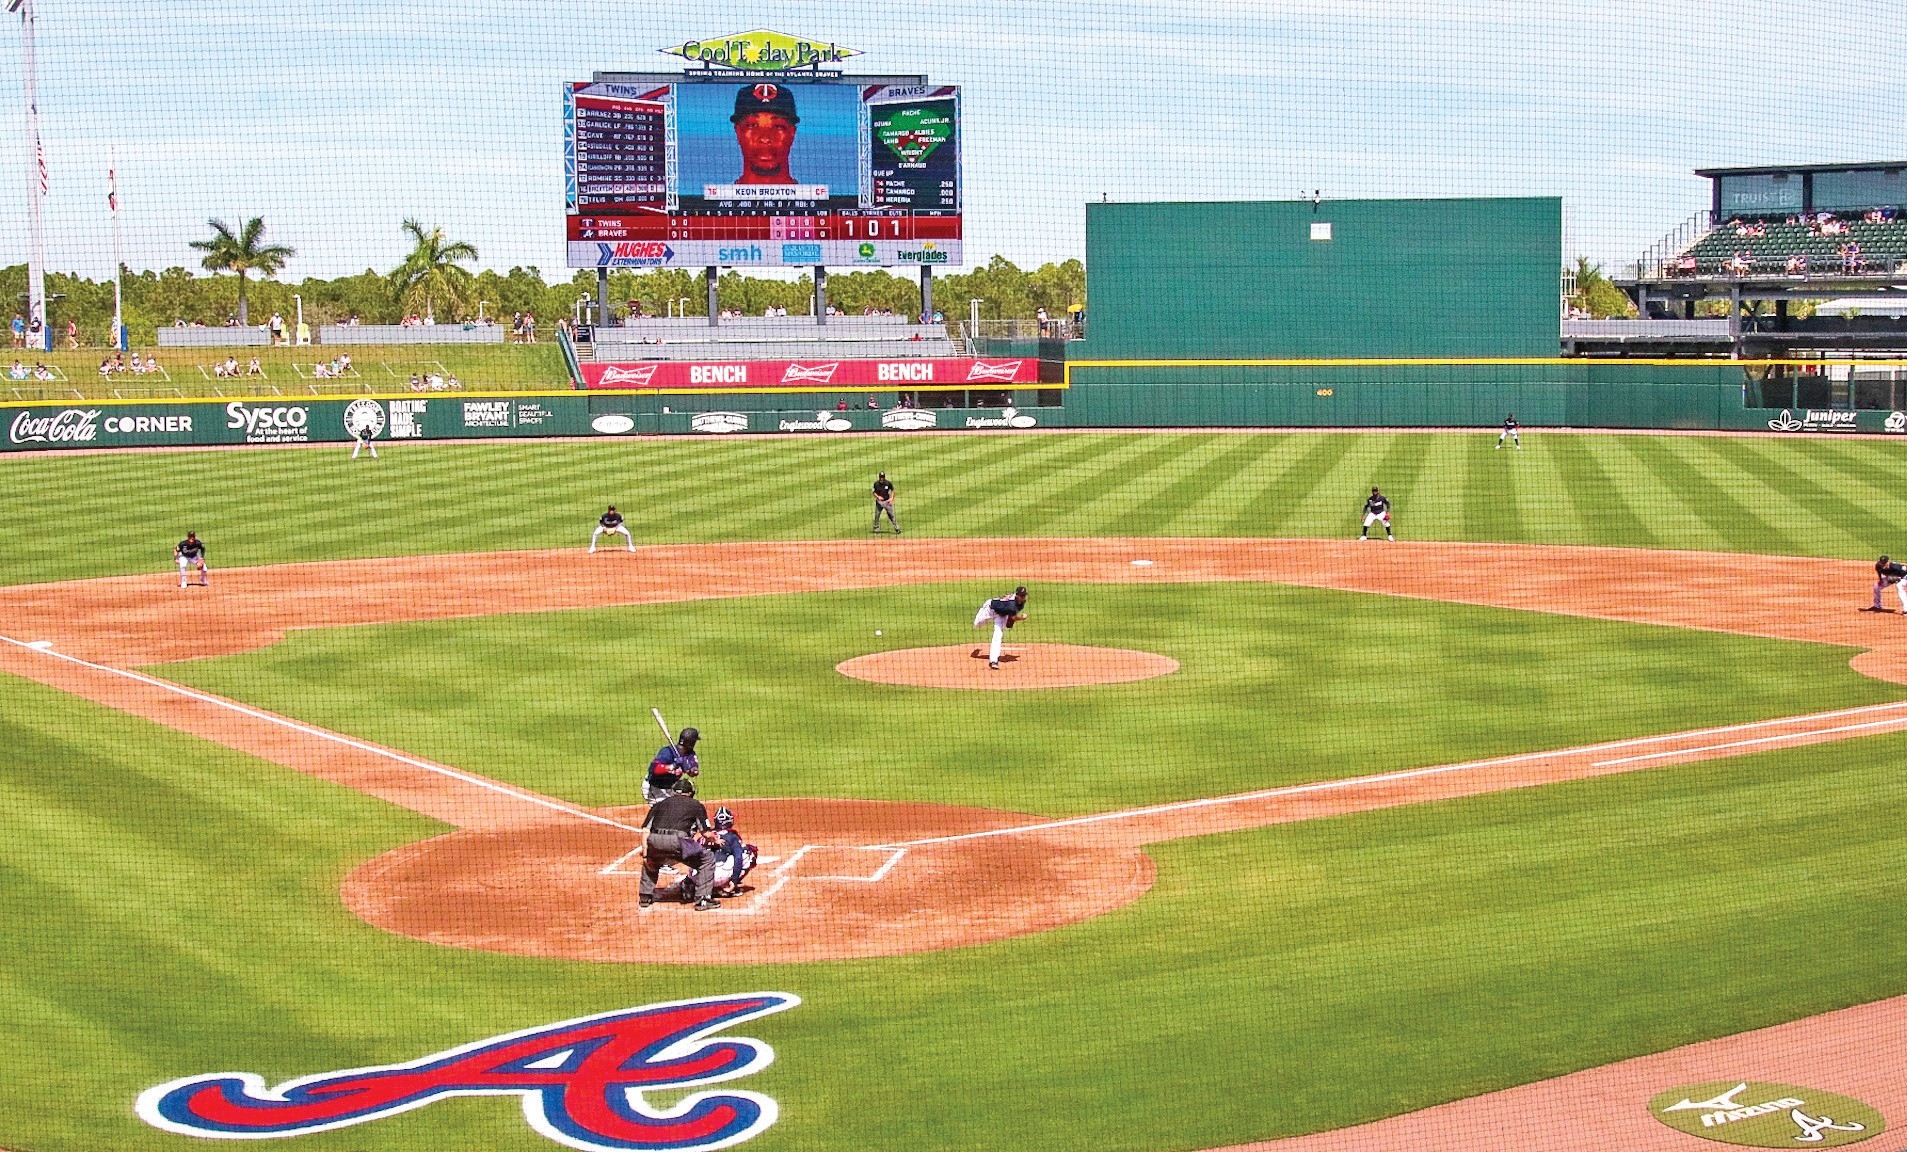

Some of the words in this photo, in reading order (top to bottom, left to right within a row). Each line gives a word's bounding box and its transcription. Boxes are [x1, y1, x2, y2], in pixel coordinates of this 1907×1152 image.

[797, 42, 842, 63] Park
[605, 84, 637, 95] TWINS
[888, 87, 925, 97] BRAVES
[845, 220, 854, 236] 1
[868, 220, 879, 236] 0
[891, 220, 899, 236] 1
[614, 242, 666, 258] HUGHES
[718, 245, 762, 261] smh
[898, 250, 948, 262] Everglades
[612, 258, 662, 266] EXTERMINATORS
[690, 365, 746, 383] BENCH
[878, 363, 933, 381] BENCH
[463, 402, 510, 412] FAWLEY
[226, 401, 308, 433] Sysco
[389, 412, 414, 425] MADE
[464, 411, 510, 421] BRYANT
[965, 417, 1008, 429] Englewood
[1803, 409, 1857, 424] Juniper
[9, 409, 102, 444] Coca-Cola
[104, 416, 192, 433] CORNER
[278, 427, 298, 435] heart
[299, 426, 308, 434] of
[389, 424, 422, 438] SIMPLE
[247, 435, 265, 443] food
[266, 435, 281, 443] and
